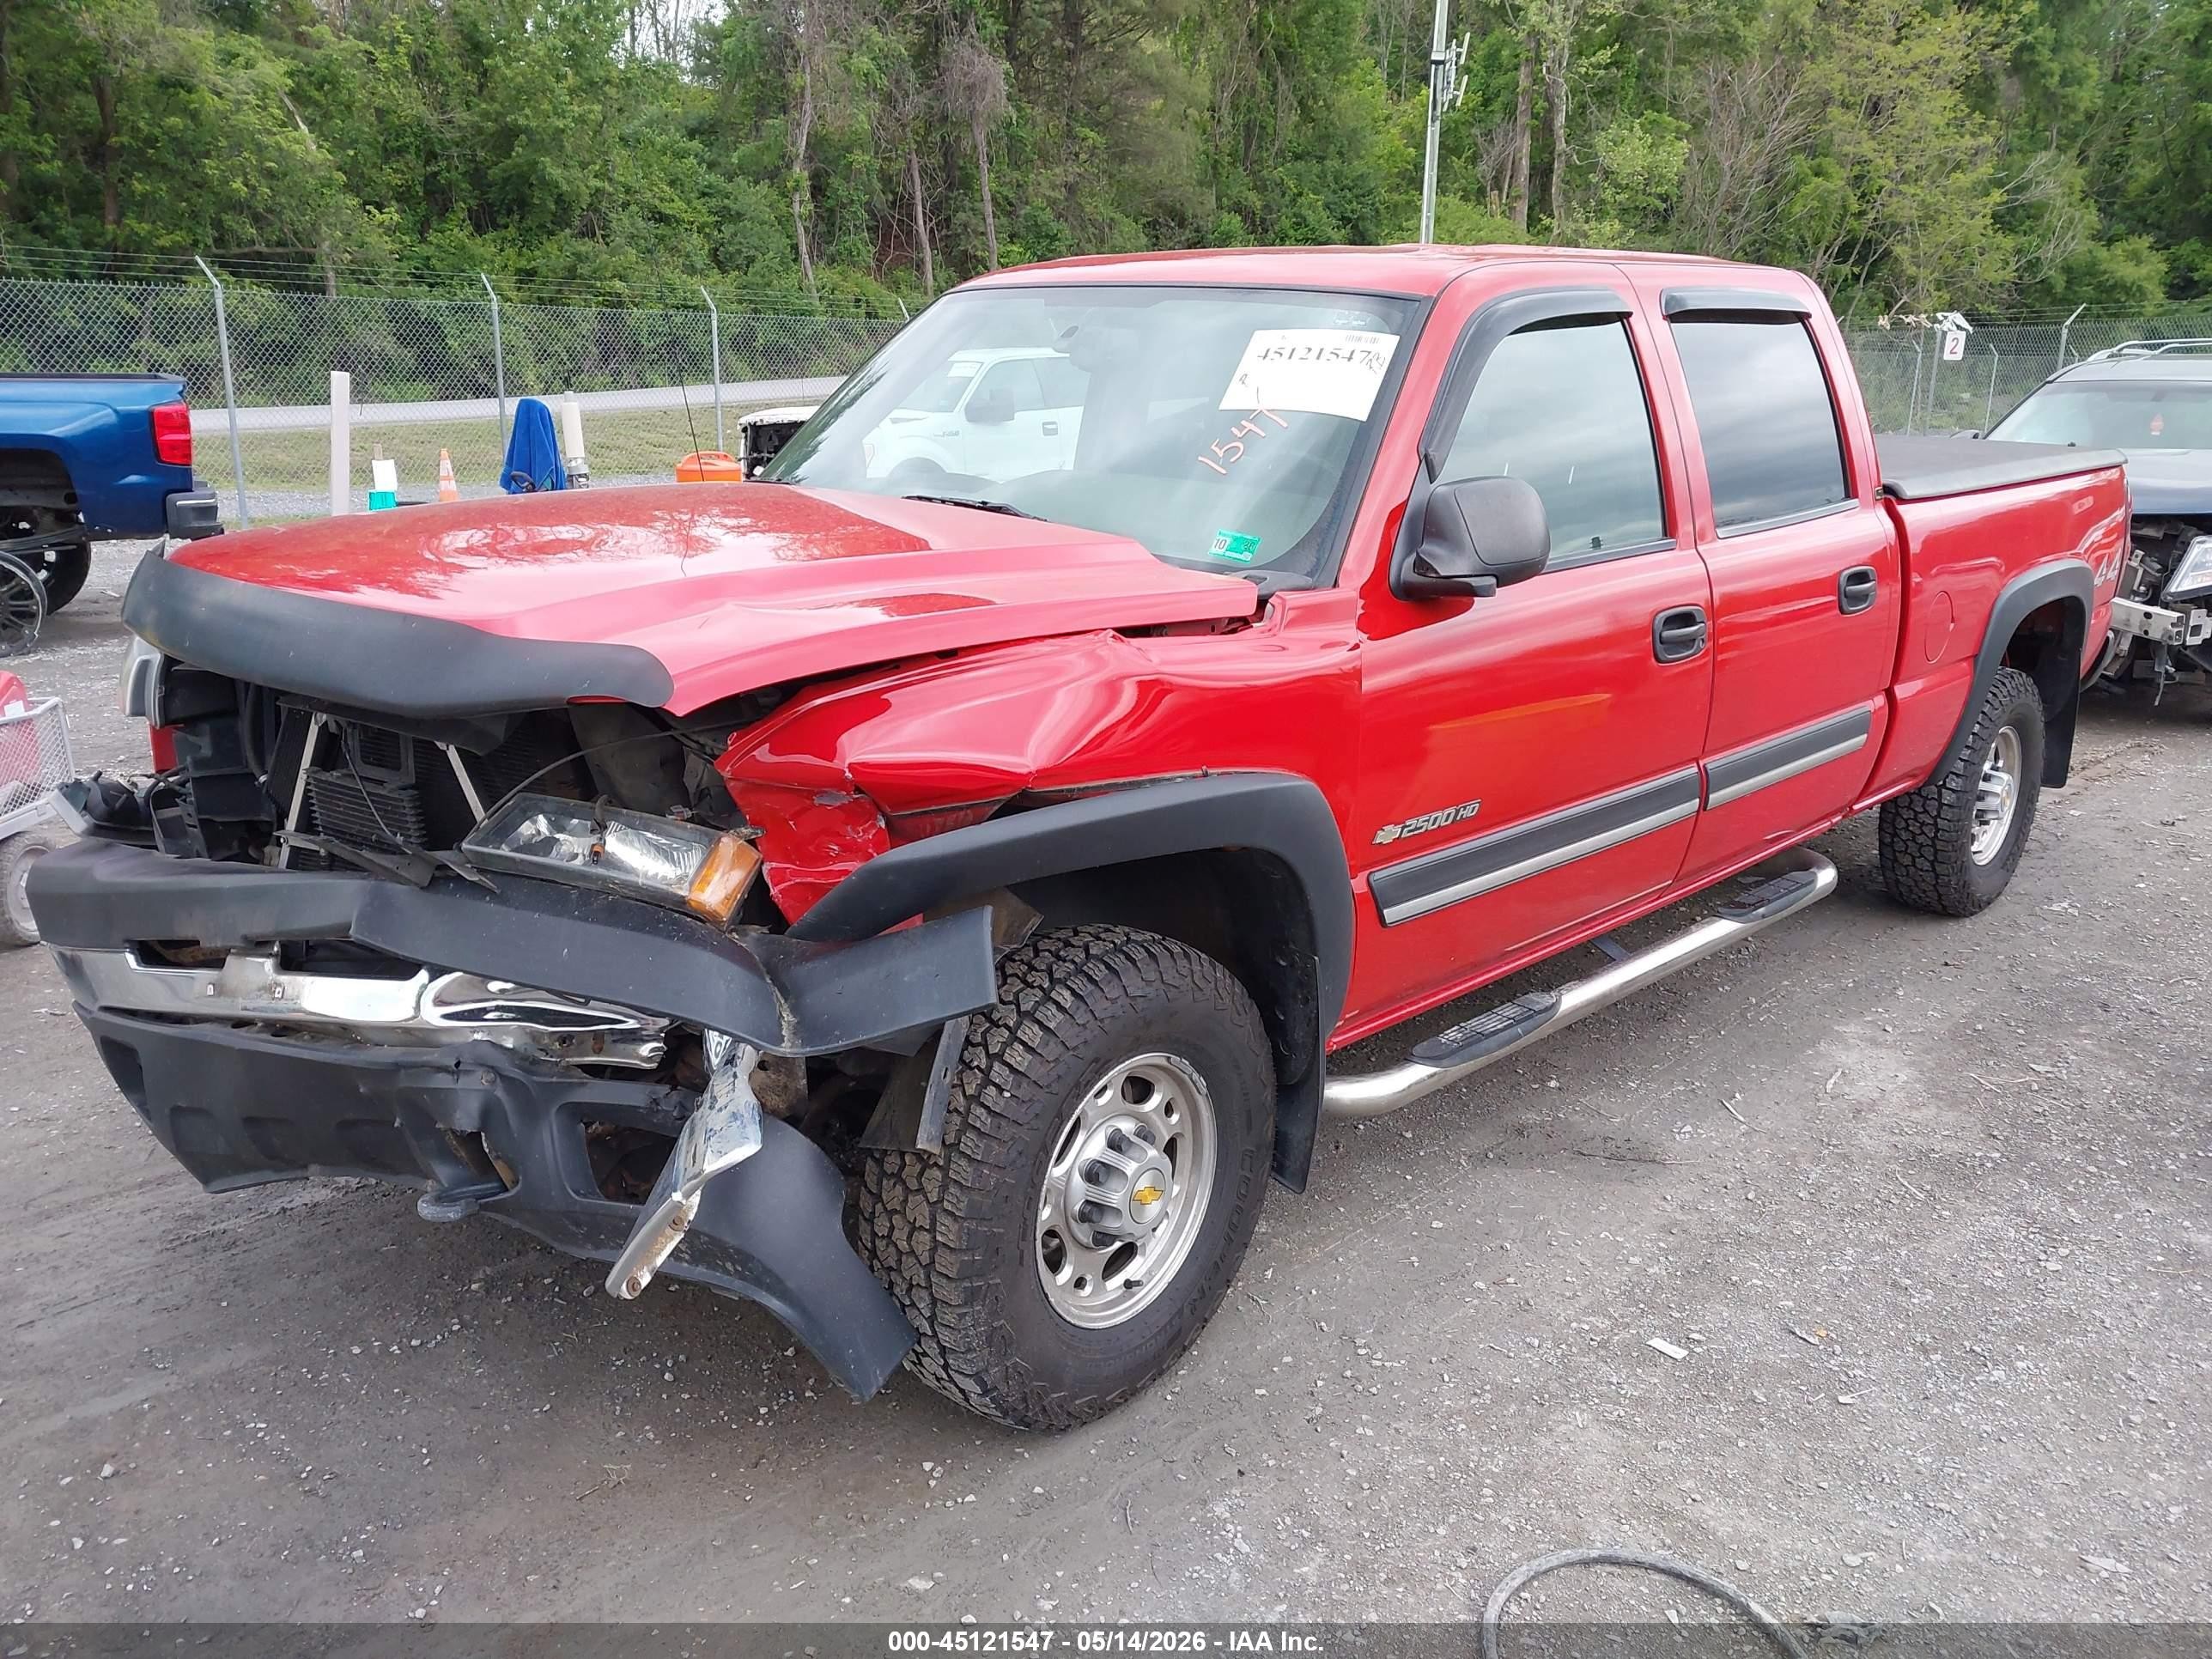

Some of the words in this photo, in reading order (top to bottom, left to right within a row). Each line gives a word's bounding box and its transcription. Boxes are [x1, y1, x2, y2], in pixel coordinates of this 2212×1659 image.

[1950, 337, 1960, 355] 2
[1257, 347, 1371, 364] 45121547
[1198, 407, 1288, 475] 1547
[1214, 538, 1227, 550] 10
[1401, 808, 1457, 838] 2500
[1457, 802, 1480, 822] HD
